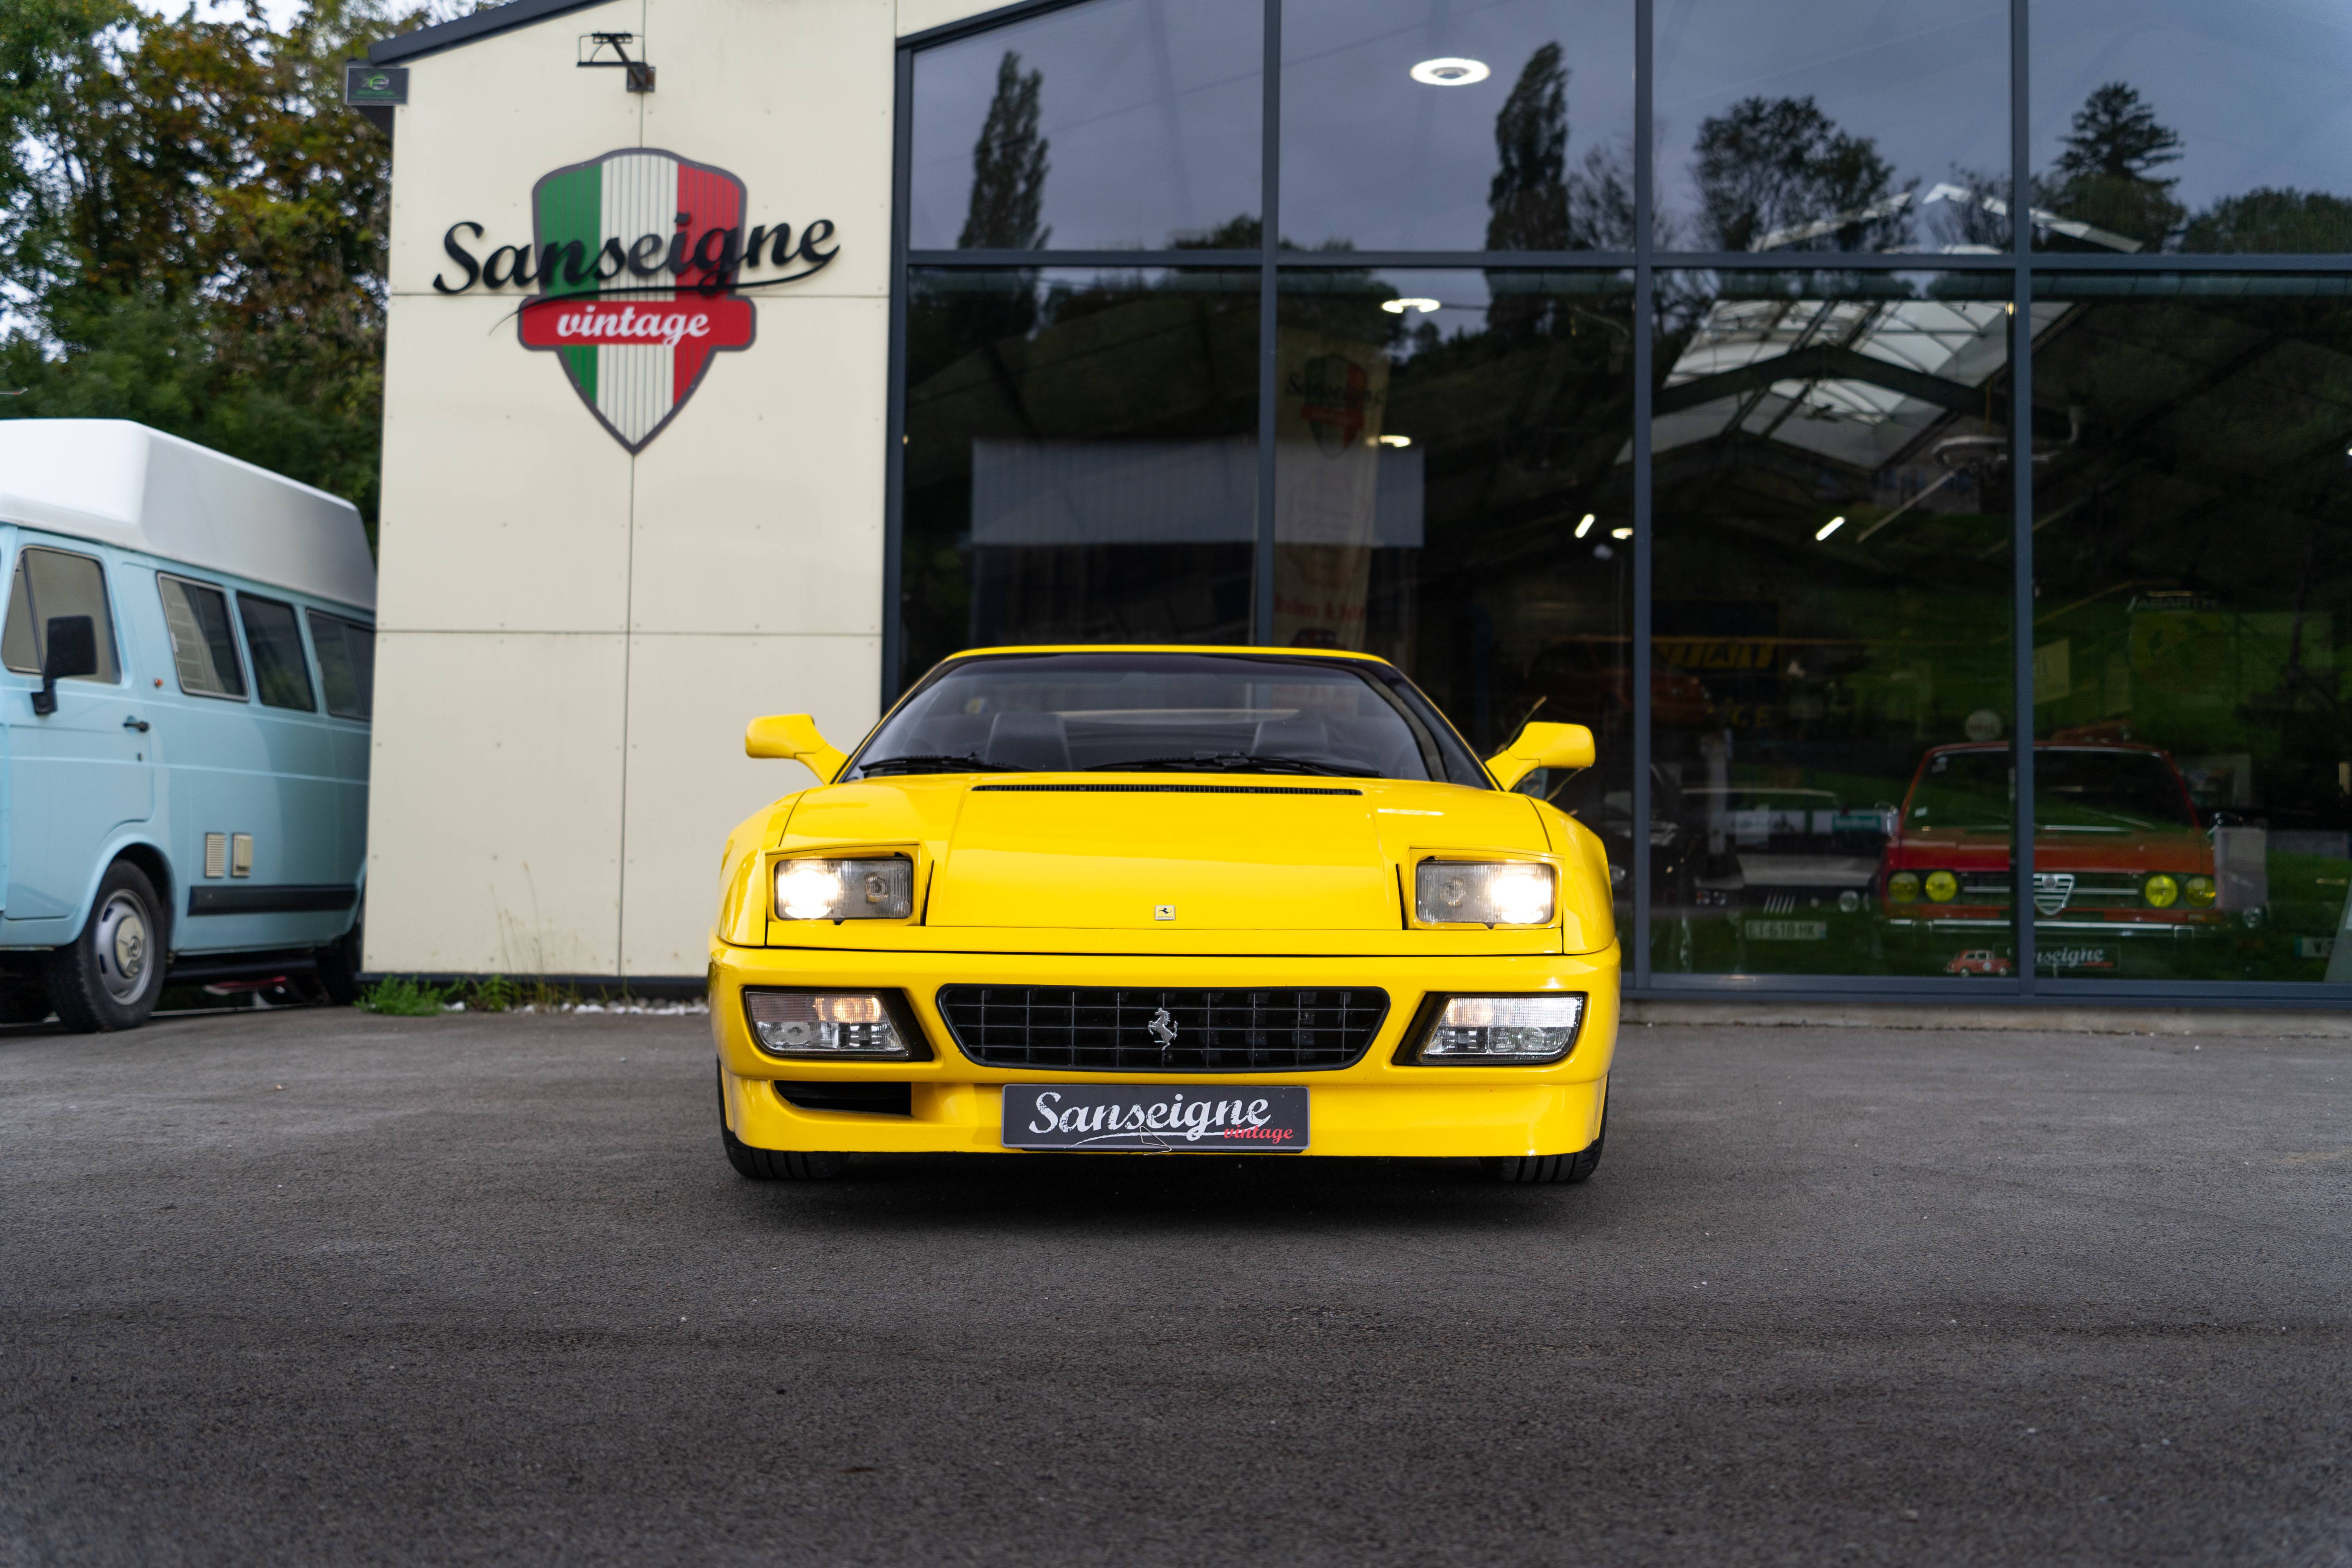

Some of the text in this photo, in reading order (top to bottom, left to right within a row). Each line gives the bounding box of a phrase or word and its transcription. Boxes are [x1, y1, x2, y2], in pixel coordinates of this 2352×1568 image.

[432, 212, 841, 299] Sanseigne
[556, 304, 711, 347] vintage
[1029, 1091, 1272, 1142] Sanseigne
[1223, 1123, 1294, 1144] vintage
